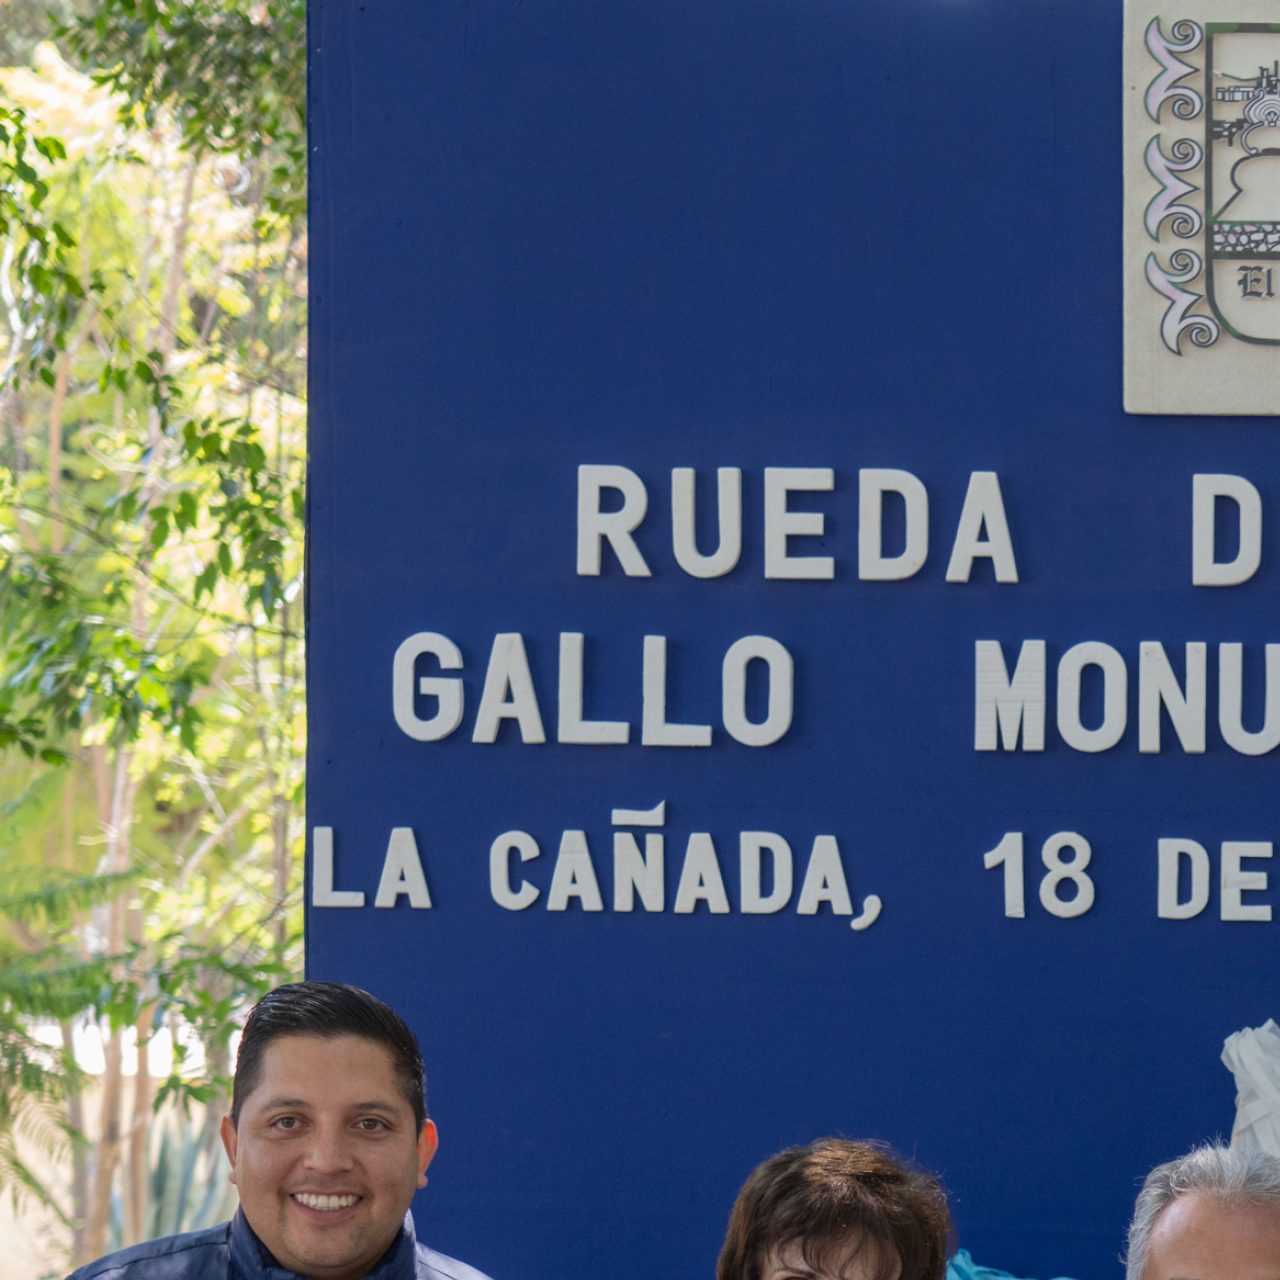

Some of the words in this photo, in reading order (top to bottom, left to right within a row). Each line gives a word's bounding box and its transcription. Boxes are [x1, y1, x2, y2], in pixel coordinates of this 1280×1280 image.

[1237, 265, 1275, 298] El
[576, 464, 1018, 583] RUEDA
[392, 631, 793, 747] GALLO
[311, 826, 432, 909] LA
[489, 800, 882, 930] CAÑADA,
[983, 832, 1095, 918] 18
[1157, 838, 1273, 921] DE
